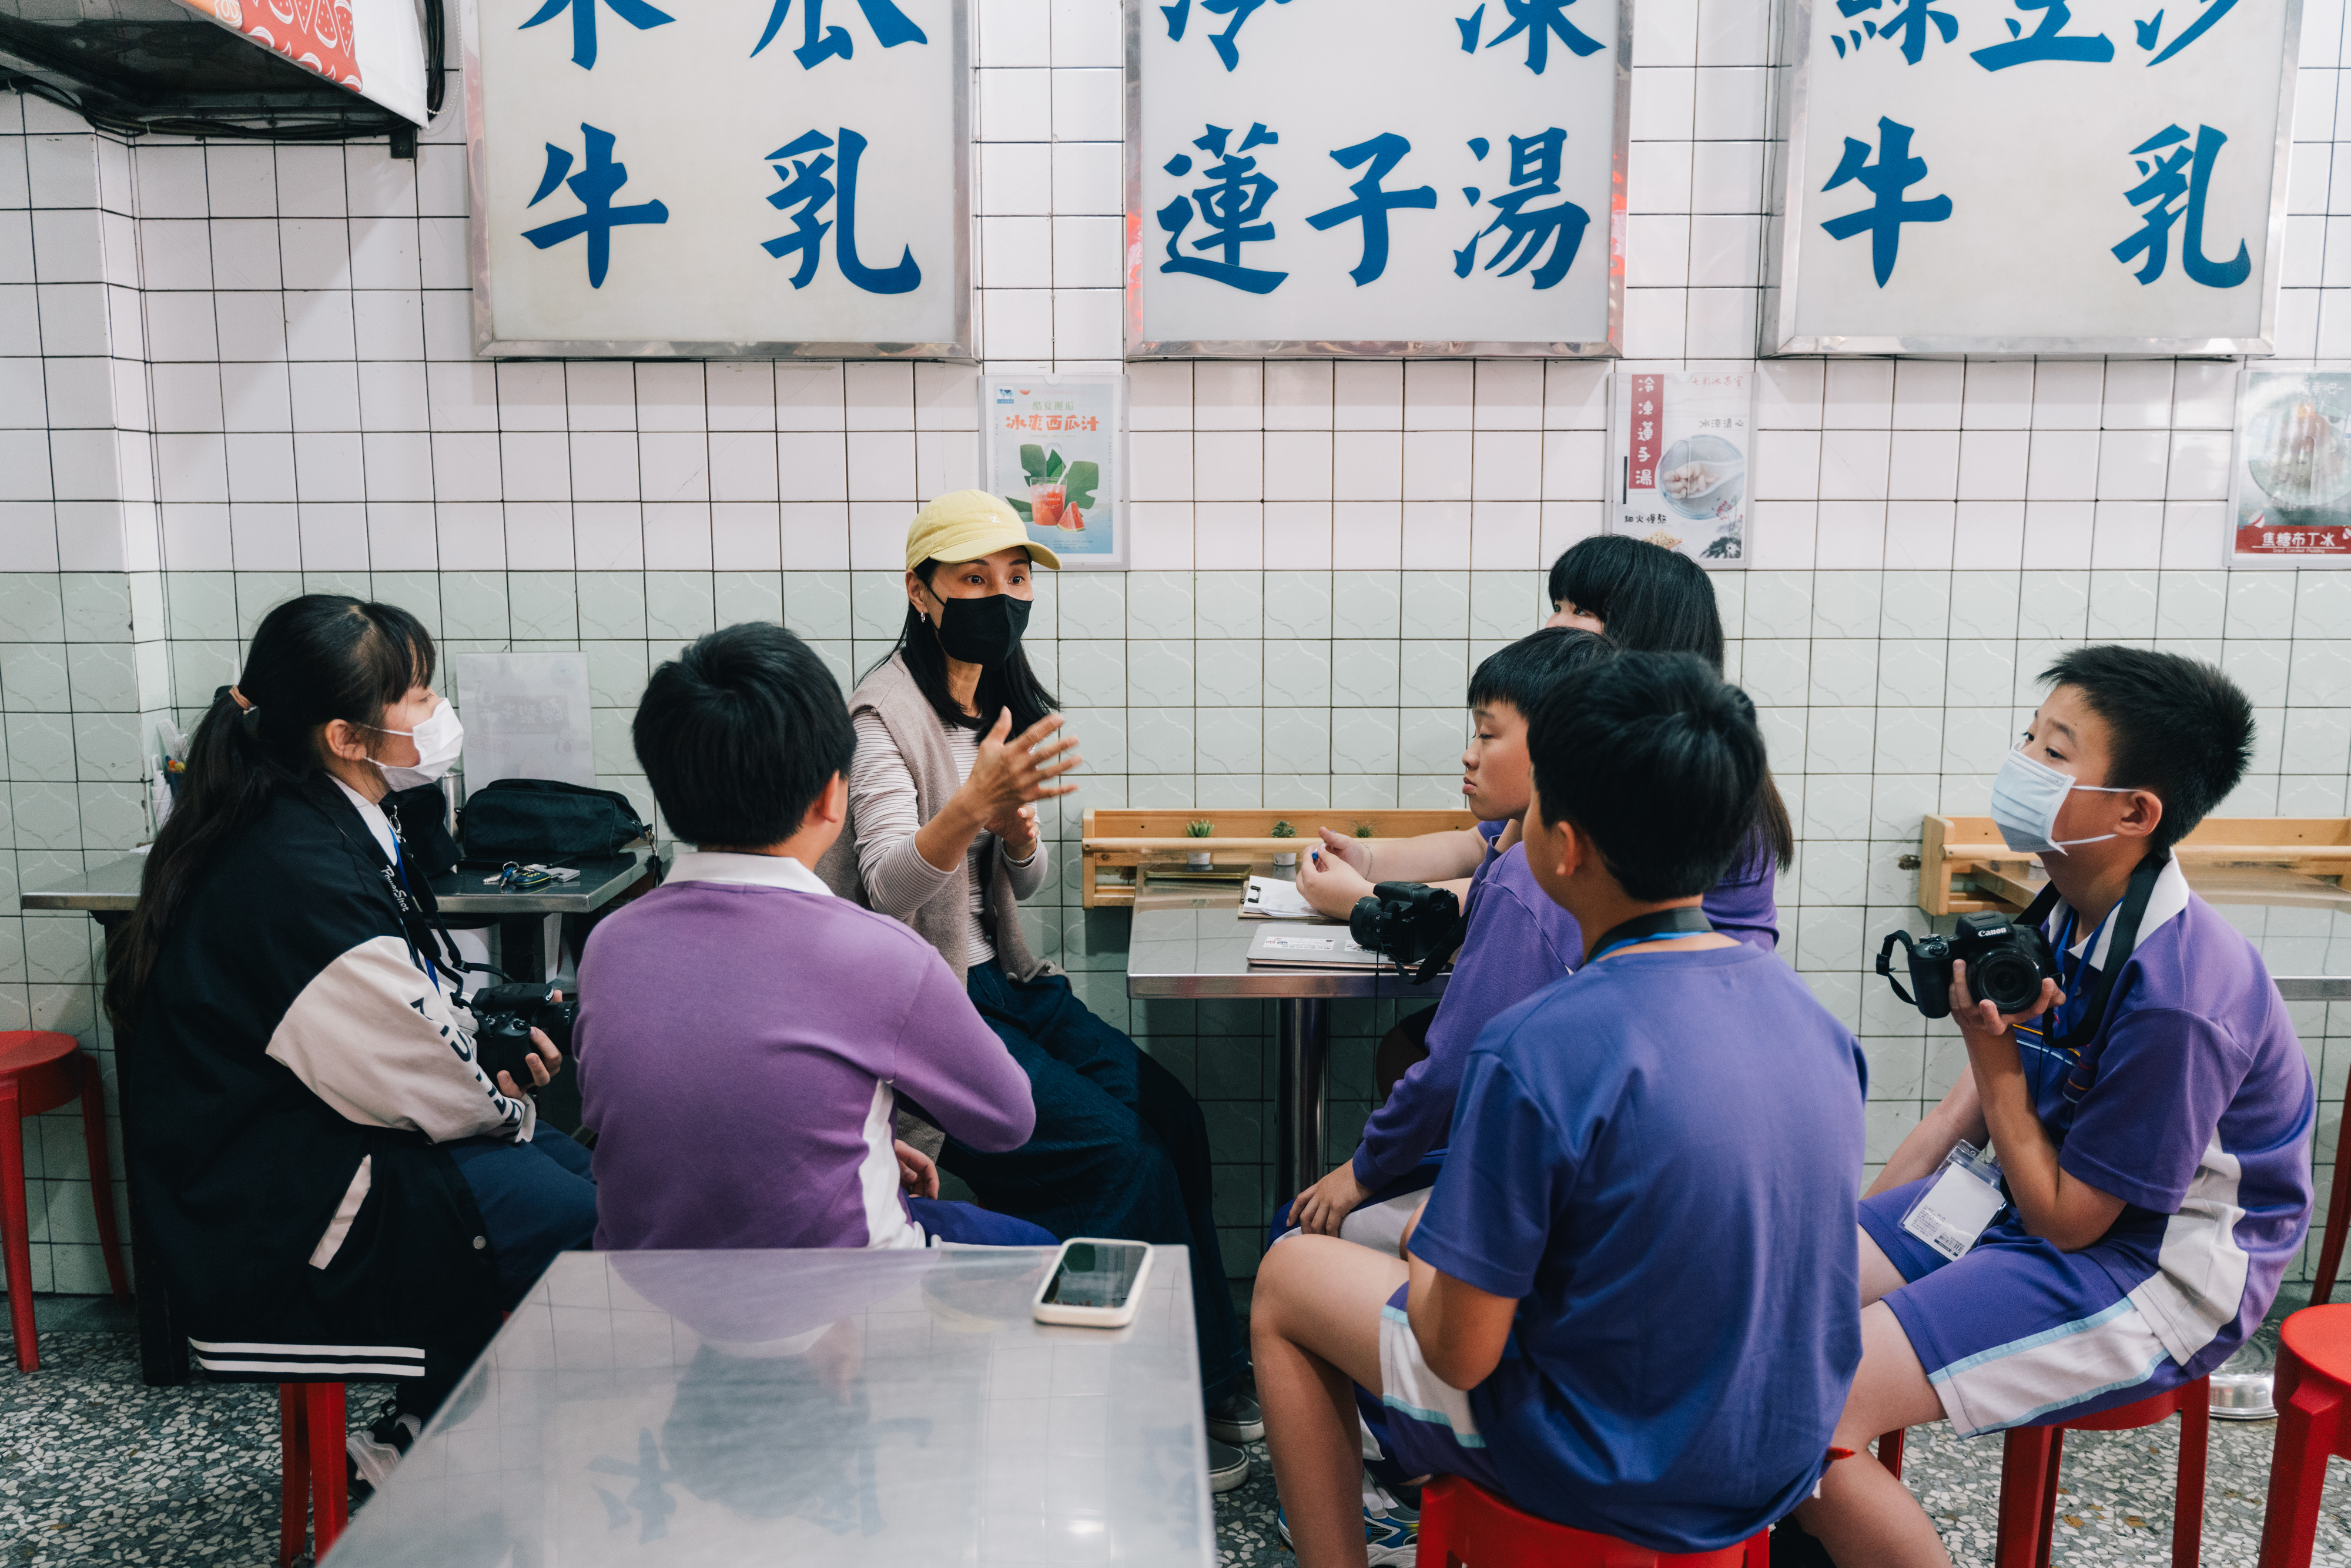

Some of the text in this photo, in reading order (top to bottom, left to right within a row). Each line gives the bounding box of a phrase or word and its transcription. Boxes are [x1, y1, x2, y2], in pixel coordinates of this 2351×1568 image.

[1157, 122, 1590, 294] 蓮子湯
[1033, 401, 1074, 410] 酷夏邂逅
[1006, 414, 1100, 431] 冰爽西瓜汁
[1636, 376, 1655, 485] 冷凍蓮子湯
[2262, 532, 2335, 547] 焦糖布丁冰
[381, 865, 409, 912] PowerShot
[1978, 927, 2007, 937] Canon
